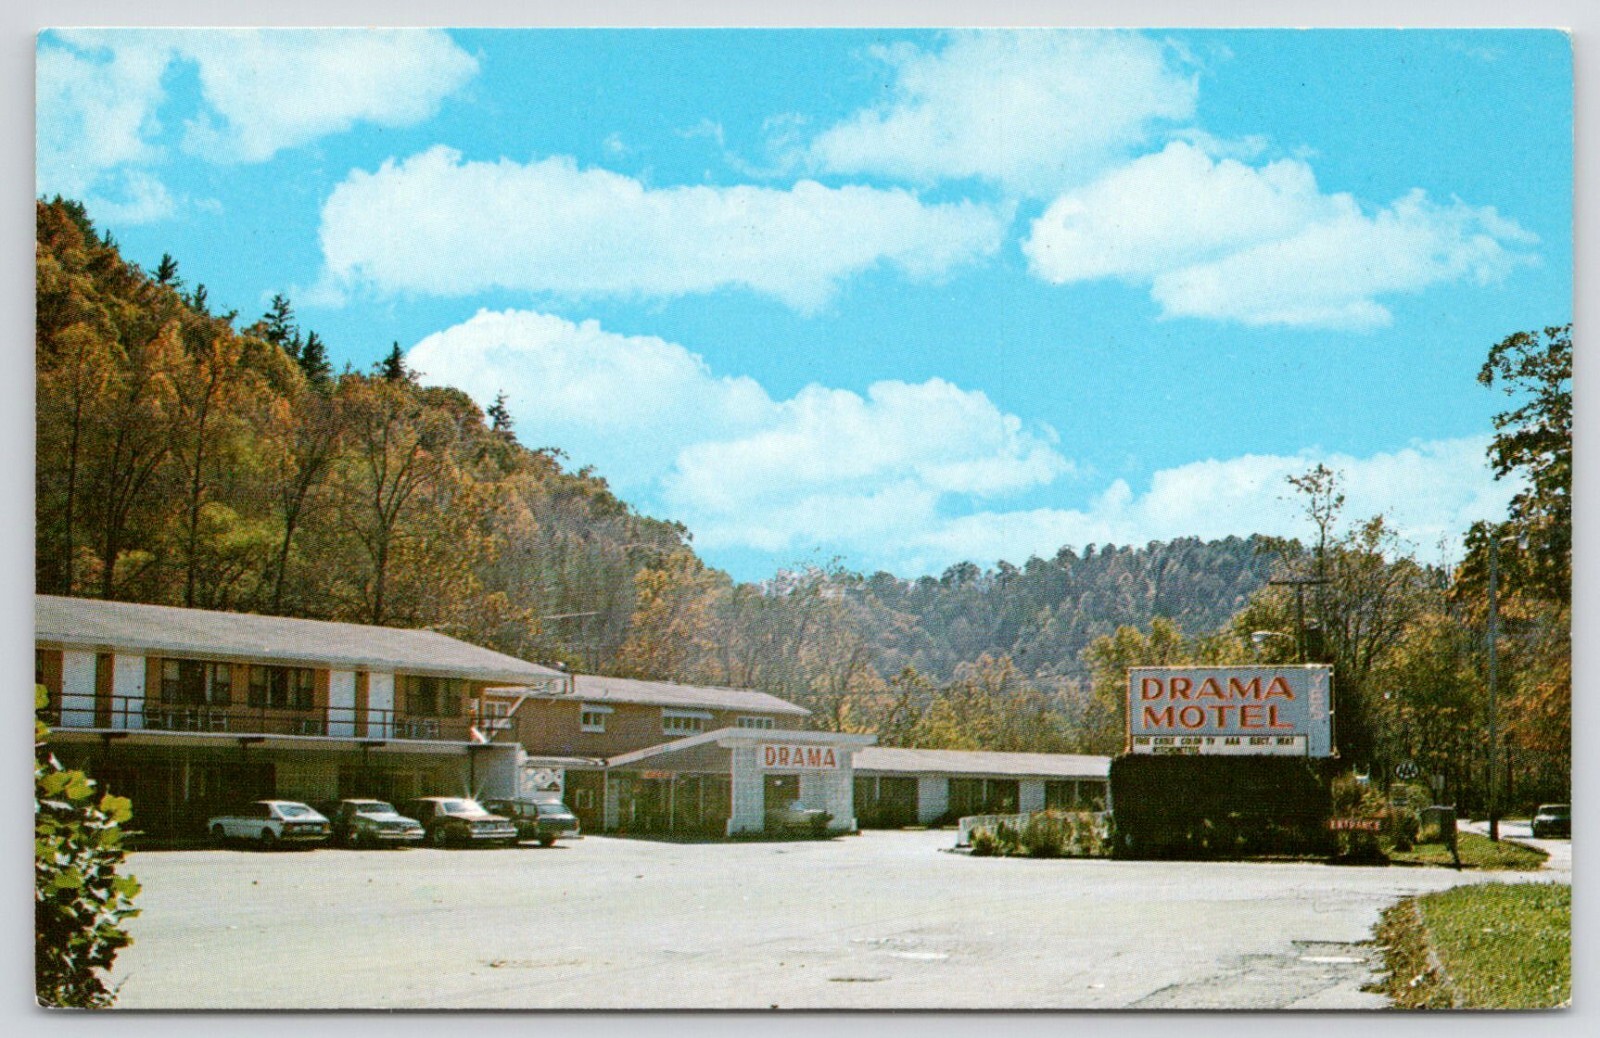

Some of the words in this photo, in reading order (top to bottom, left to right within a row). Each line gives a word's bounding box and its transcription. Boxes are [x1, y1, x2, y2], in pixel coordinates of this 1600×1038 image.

[1140, 676, 1296, 701] DRAMA
[1142, 704, 1296, 730] MOTEL
[1224, 736, 1241, 746] AAA
[765, 746, 836, 768] DRAMA
